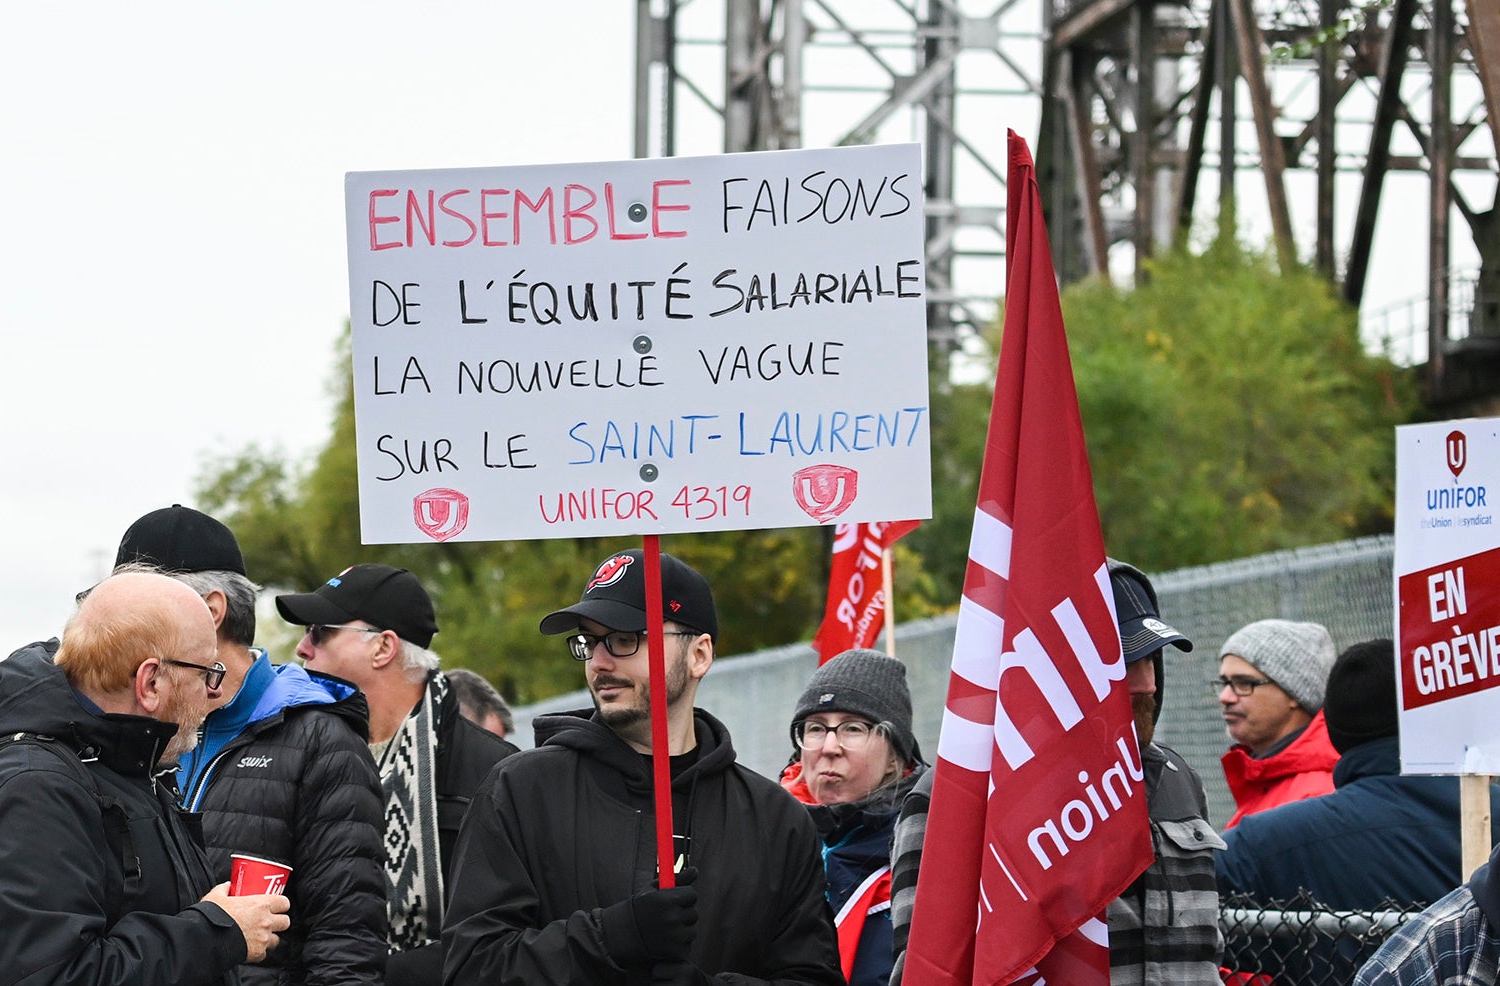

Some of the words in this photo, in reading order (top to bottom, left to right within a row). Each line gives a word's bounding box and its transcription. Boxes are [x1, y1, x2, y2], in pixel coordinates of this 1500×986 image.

[368, 179, 692, 252] ENSEMBLE
[723, 170, 911, 234] FAISONS
[372, 279, 421, 327] DE
[709, 260, 921, 318] SALARIALE
[373, 355, 431, 395] LA
[458, 355, 665, 395] NOUVELLE
[698, 341, 844, 386] VAGUE
[375, 434, 459, 481] SUR
[483, 431, 537, 469] LE
[568, 407, 928, 466] SAINT-LAURENT
[539, 488, 656, 525] UNIFOR
[671, 484, 752, 522] 4319
[1428, 566, 1467, 623] EN
